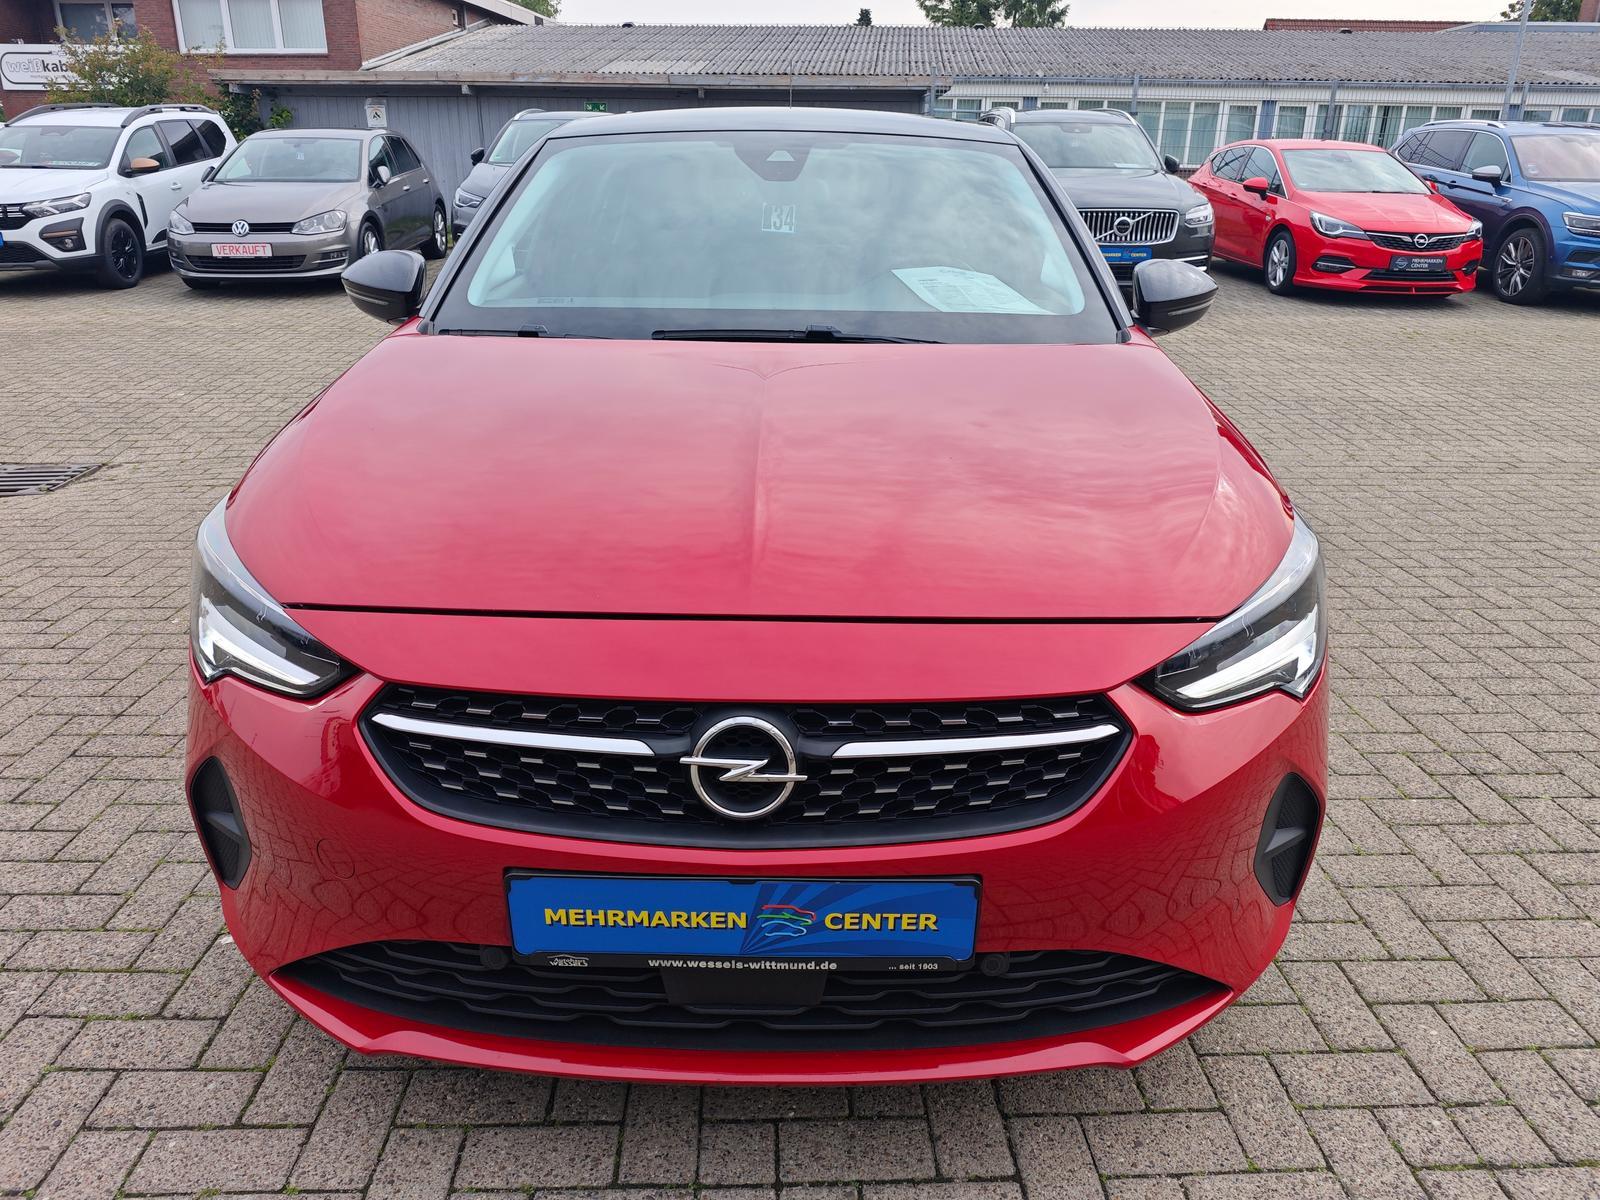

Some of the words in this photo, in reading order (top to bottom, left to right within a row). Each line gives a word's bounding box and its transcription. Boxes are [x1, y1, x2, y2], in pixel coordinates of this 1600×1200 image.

[215, 245, 267, 255] VERKAUFT
[544, 908, 748, 929] MEHRMARKEN
[824, 912, 939, 932] CENTER
[648, 959, 838, 970] www.wessels-wittmund.de
